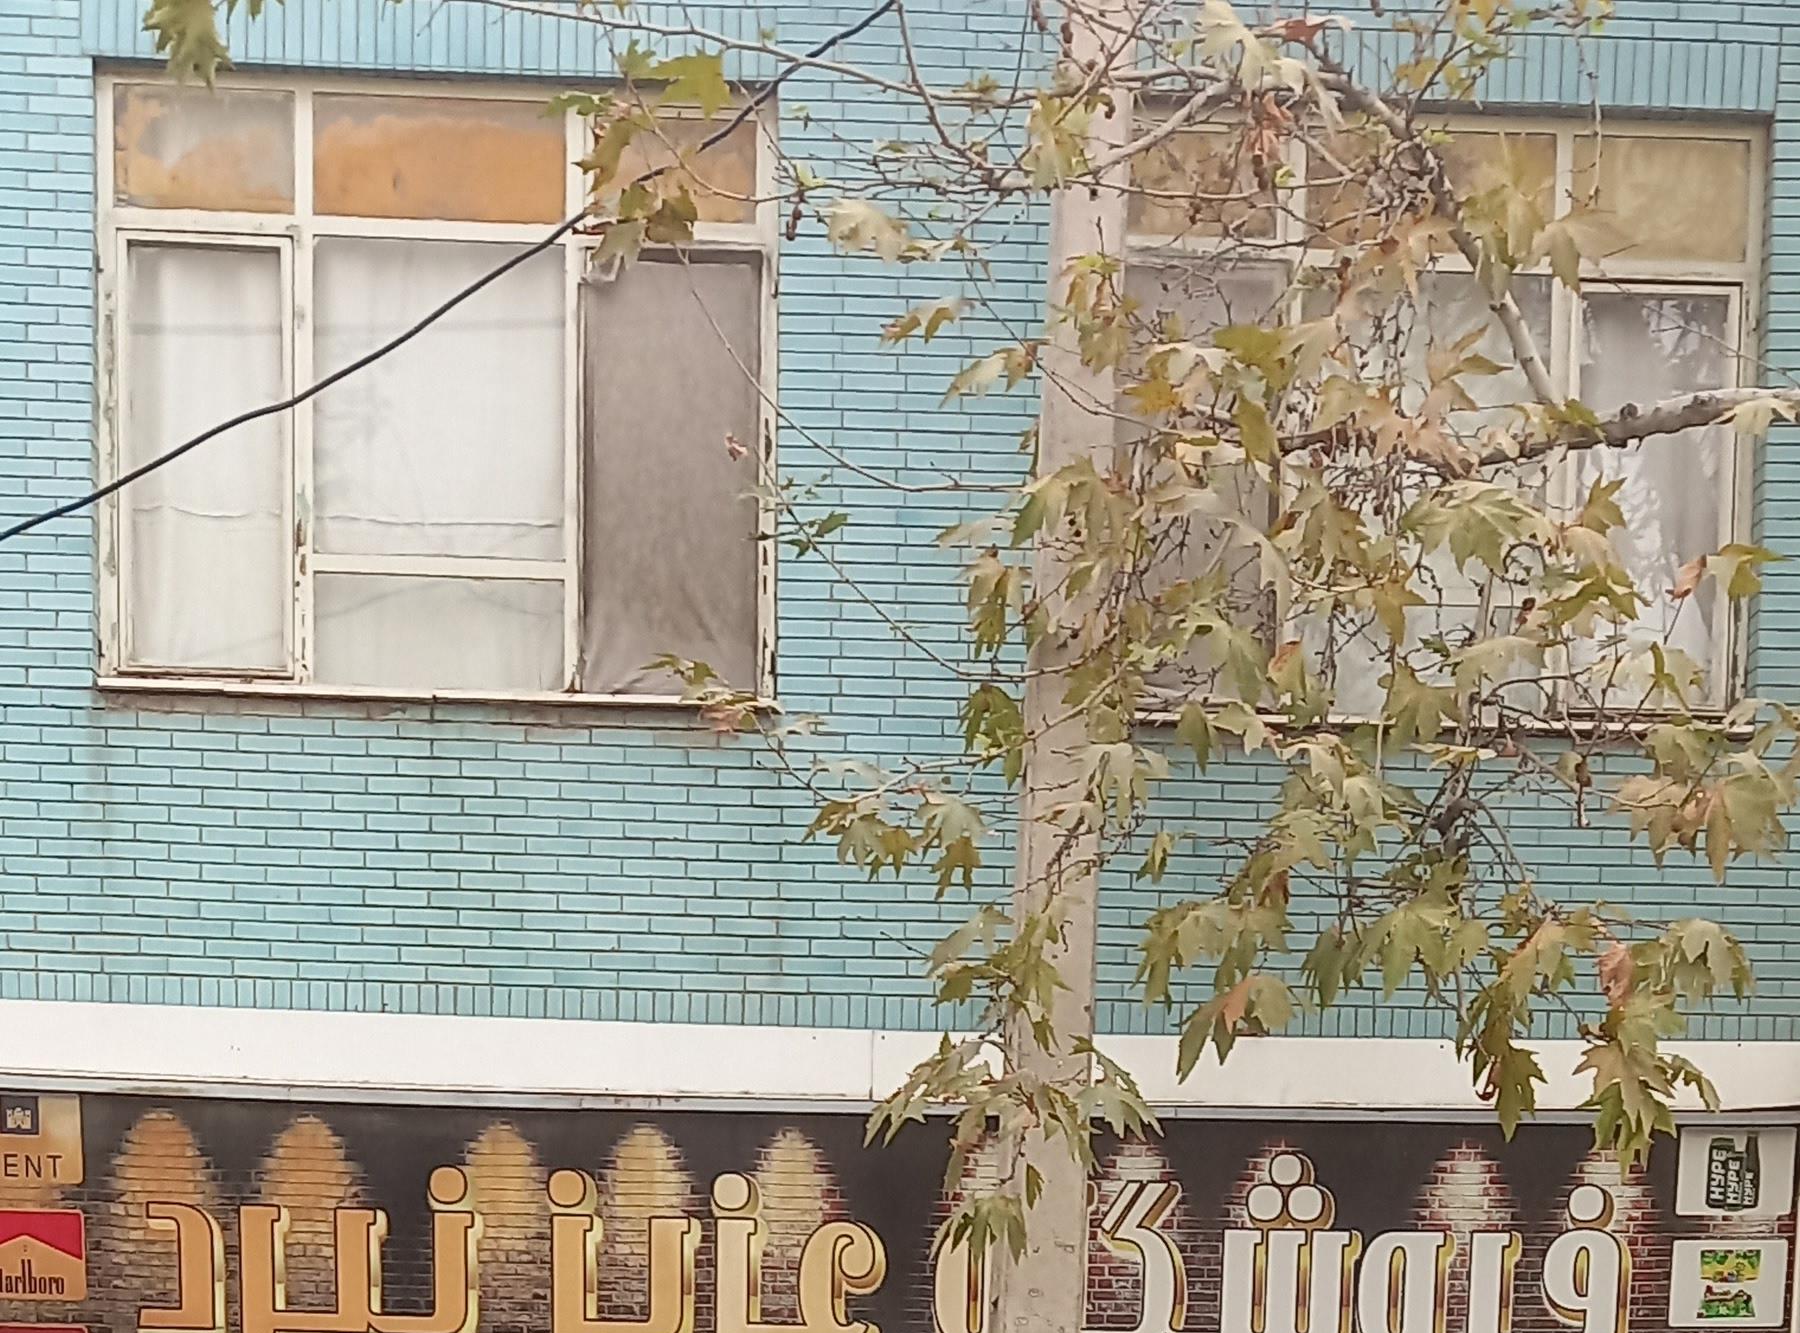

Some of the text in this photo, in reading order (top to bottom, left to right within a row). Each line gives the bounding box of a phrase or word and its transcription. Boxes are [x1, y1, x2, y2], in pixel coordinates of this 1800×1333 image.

[3, 1153, 63, 1178] ENT
[1709, 1149, 1727, 1200] HYPE
[1726, 1160, 1740, 1204] HYPE
[0, 1258, 65, 1295] arlboro
